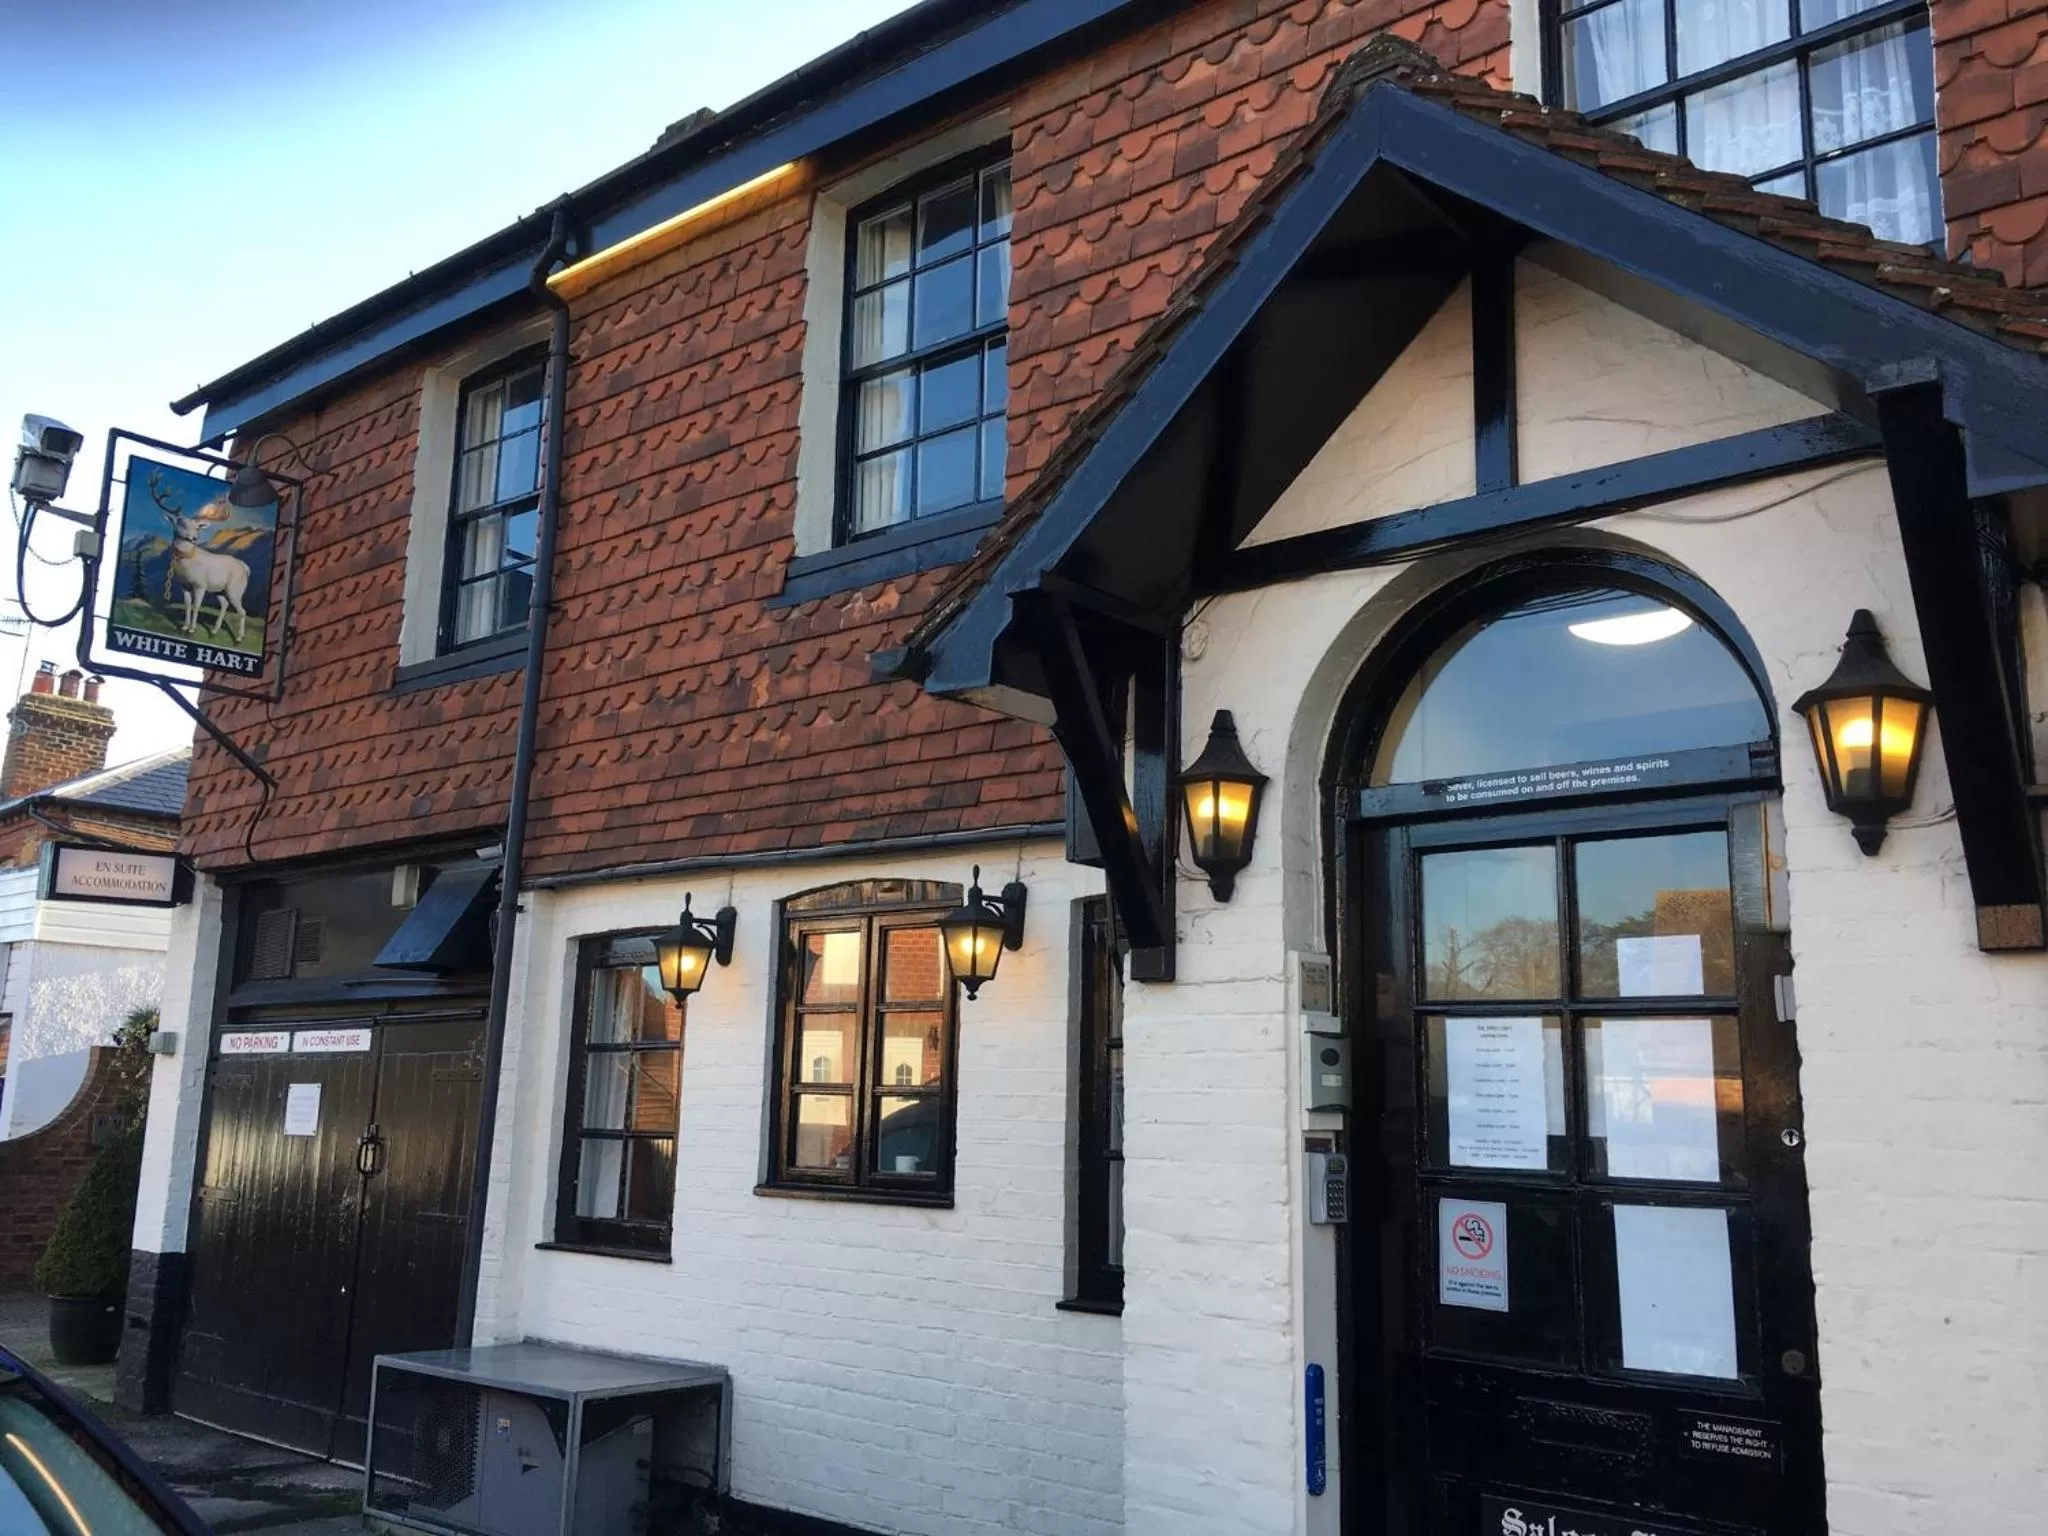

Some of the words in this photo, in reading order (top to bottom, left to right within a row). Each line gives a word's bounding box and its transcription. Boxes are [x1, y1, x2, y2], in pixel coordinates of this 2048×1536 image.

[114, 630, 188, 659] WHITE
[196, 647, 258, 672] HART
[1477, 776, 1515, 788] licensed
[1517, 775, 1527, 784] to
[1530, 772, 1547, 781] sell
[1548, 770, 1579, 781] beers,
[1581, 766, 1611, 776] wines
[1613, 762, 1633, 773] and
[1636, 759, 1670, 772] spirits
[1446, 794, 1455, 802] to
[1457, 792, 1468, 801] be
[1470, 786, 1519, 800] consumed
[1520, 786, 1533, 794] on
[1535, 782, 1554, 792] and
[1556, 779, 1570, 790] off
[1572, 779, 1588, 788] the
[1590, 774, 1641, 788] premises.
[96, 861, 111, 873] EN
[113, 863, 145, 876] SUITE
[72, 875, 168, 893] ACCOMMODATION
[230, 1036, 242, 1050] NO
[243, 1035, 279, 1049] PARKING
[309, 1035, 346, 1047] CONSTANT
[347, 1034, 361, 1047] USE
[1697, 1420, 1711, 1431] THE
[1712, 1424, 1762, 1438] MANAGEMENT
[1692, 1430, 1728, 1443] RESERVES
[1729, 1435, 1744, 1446] THE
[1745, 1438, 1768, 1448] RIGHT
[1691, 1439, 1701, 1450] TO
[1702, 1441, 1730, 1454] REFUSE
[1731, 1446, 1772, 1459] ADMISSION
